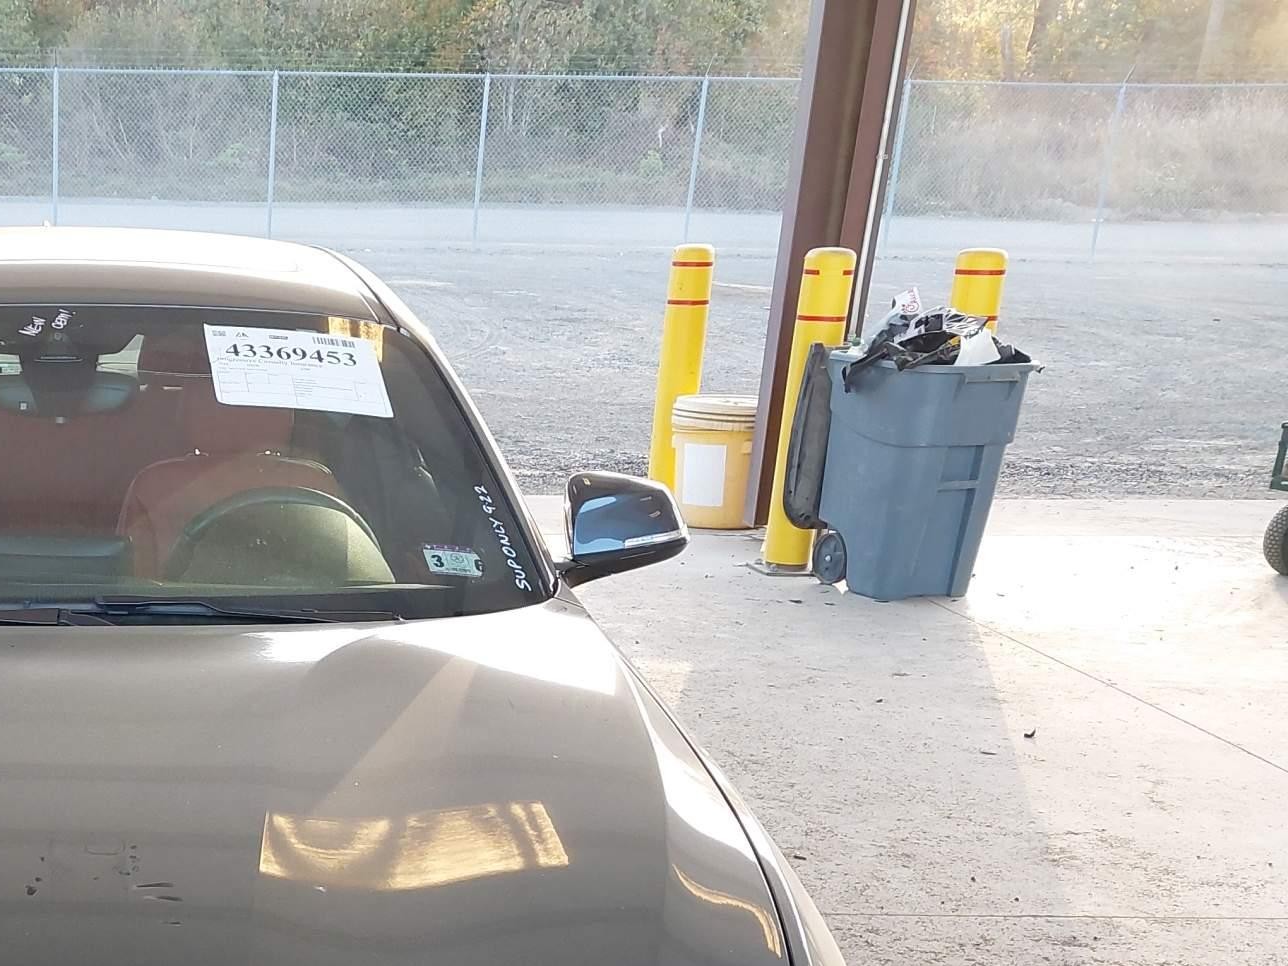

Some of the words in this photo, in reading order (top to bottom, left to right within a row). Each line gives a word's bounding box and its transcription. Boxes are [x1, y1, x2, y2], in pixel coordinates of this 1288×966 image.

[18, 316, 46, 336] NEW
[225, 343, 357, 367] 43369453
[430, 554, 445, 568] 3
